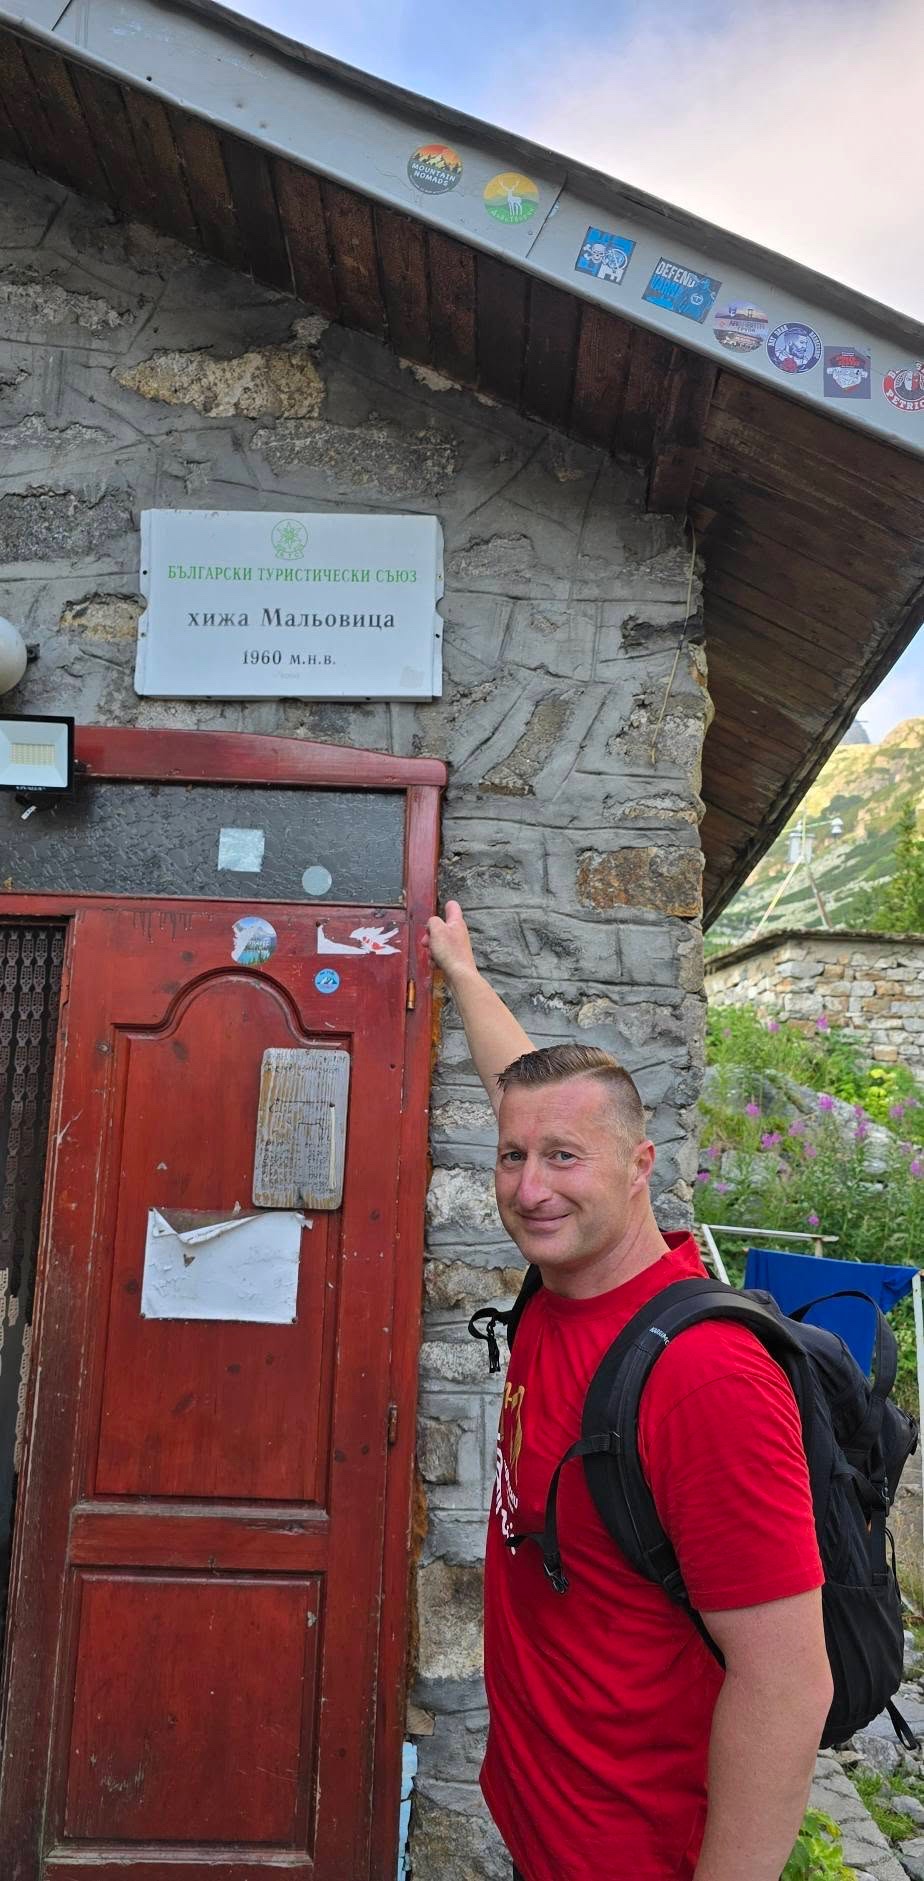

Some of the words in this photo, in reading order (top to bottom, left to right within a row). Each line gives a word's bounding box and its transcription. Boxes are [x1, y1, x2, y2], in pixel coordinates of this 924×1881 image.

[411, 162, 456, 182] MOUNTAIN
[413, 170, 449, 187] NOMADS
[655, 261, 697, 288] DEFEND
[167, 565, 252, 581] БЪЛГАРСКИ
[258, 567, 370, 583] ТУРИСТИЧЕСКИ
[376, 568, 417, 583] СЪЮЗ
[188, 611, 249, 627] хижа
[261, 608, 395, 631] Мальовица
[242, 650, 282, 665] 1960
[289, 652, 337, 665] м.н.в.
